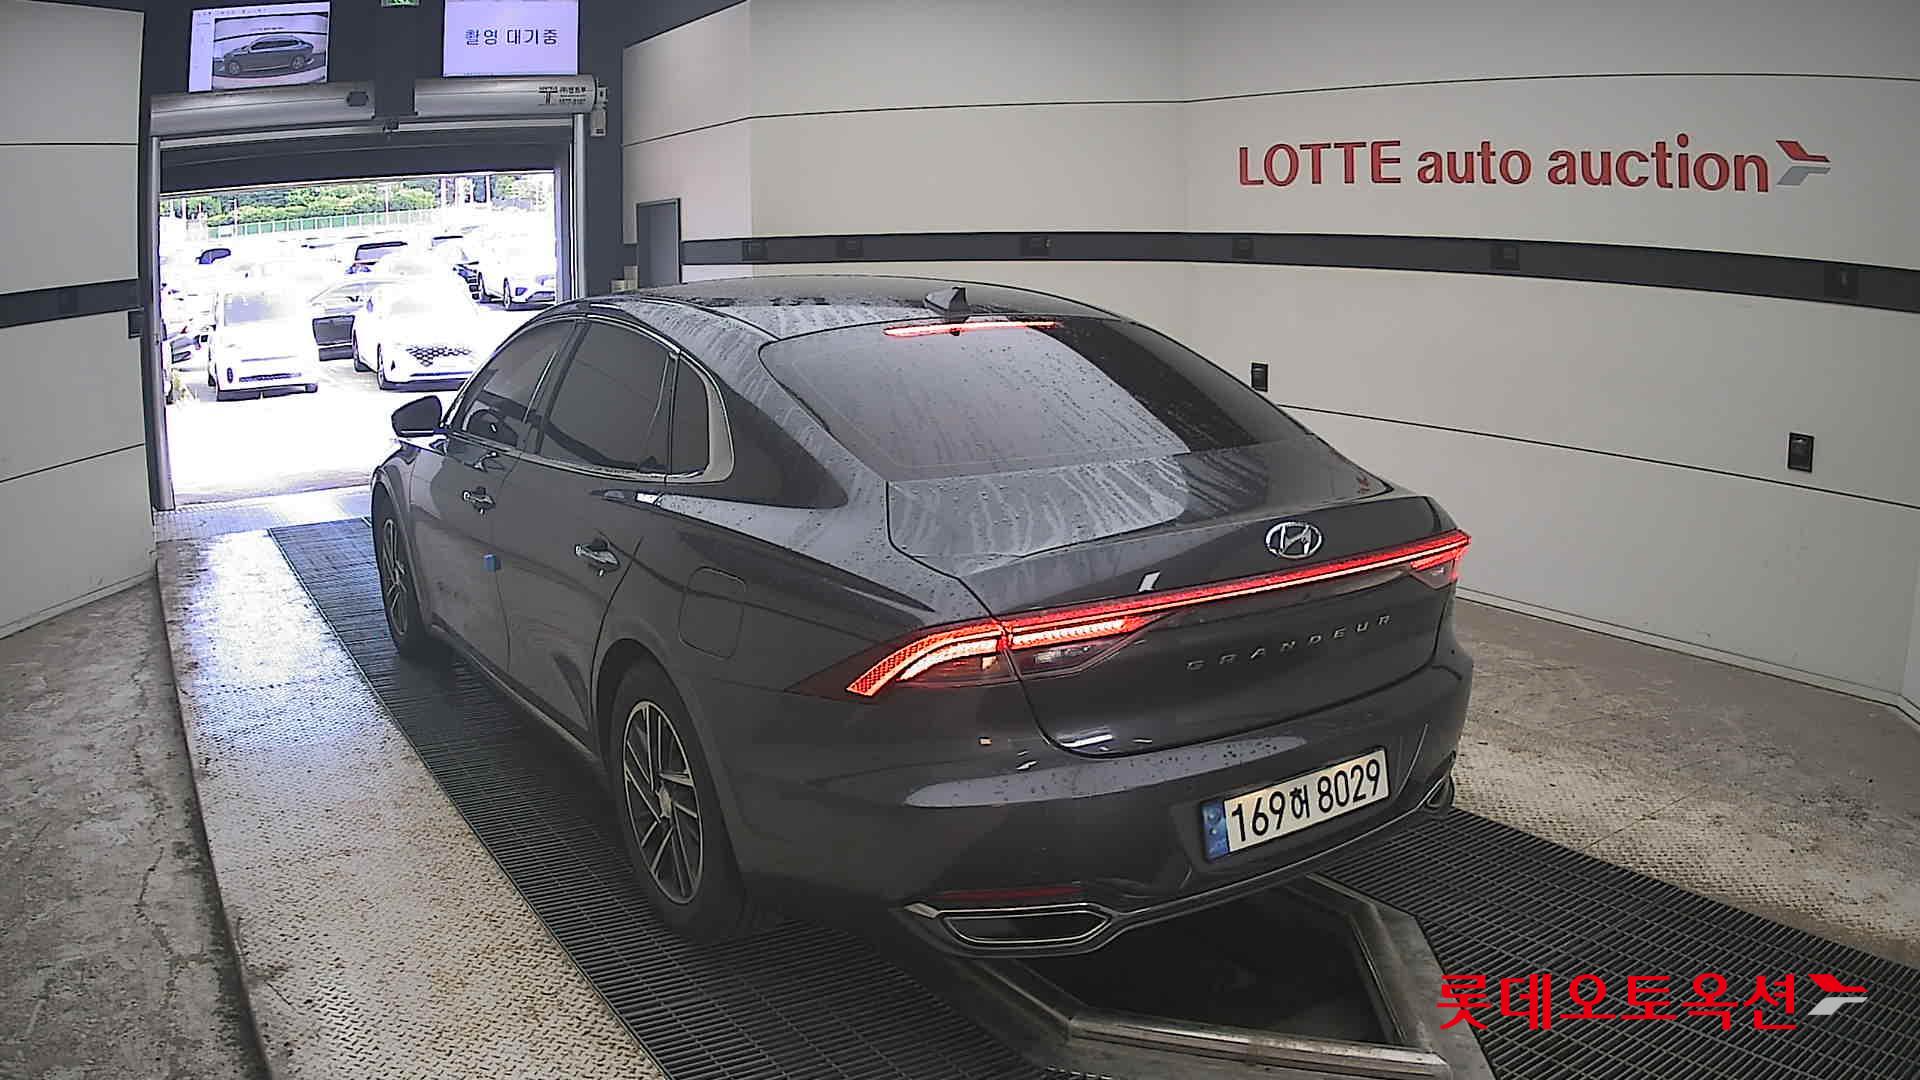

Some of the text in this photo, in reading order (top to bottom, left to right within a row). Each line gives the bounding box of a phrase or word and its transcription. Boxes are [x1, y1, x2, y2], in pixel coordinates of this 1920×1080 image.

[1239, 133, 1769, 192] LOTTE auto auction
[1186, 614, 1390, 671] GRANDEUR
[1231, 758, 1380, 842] 169허 8029
